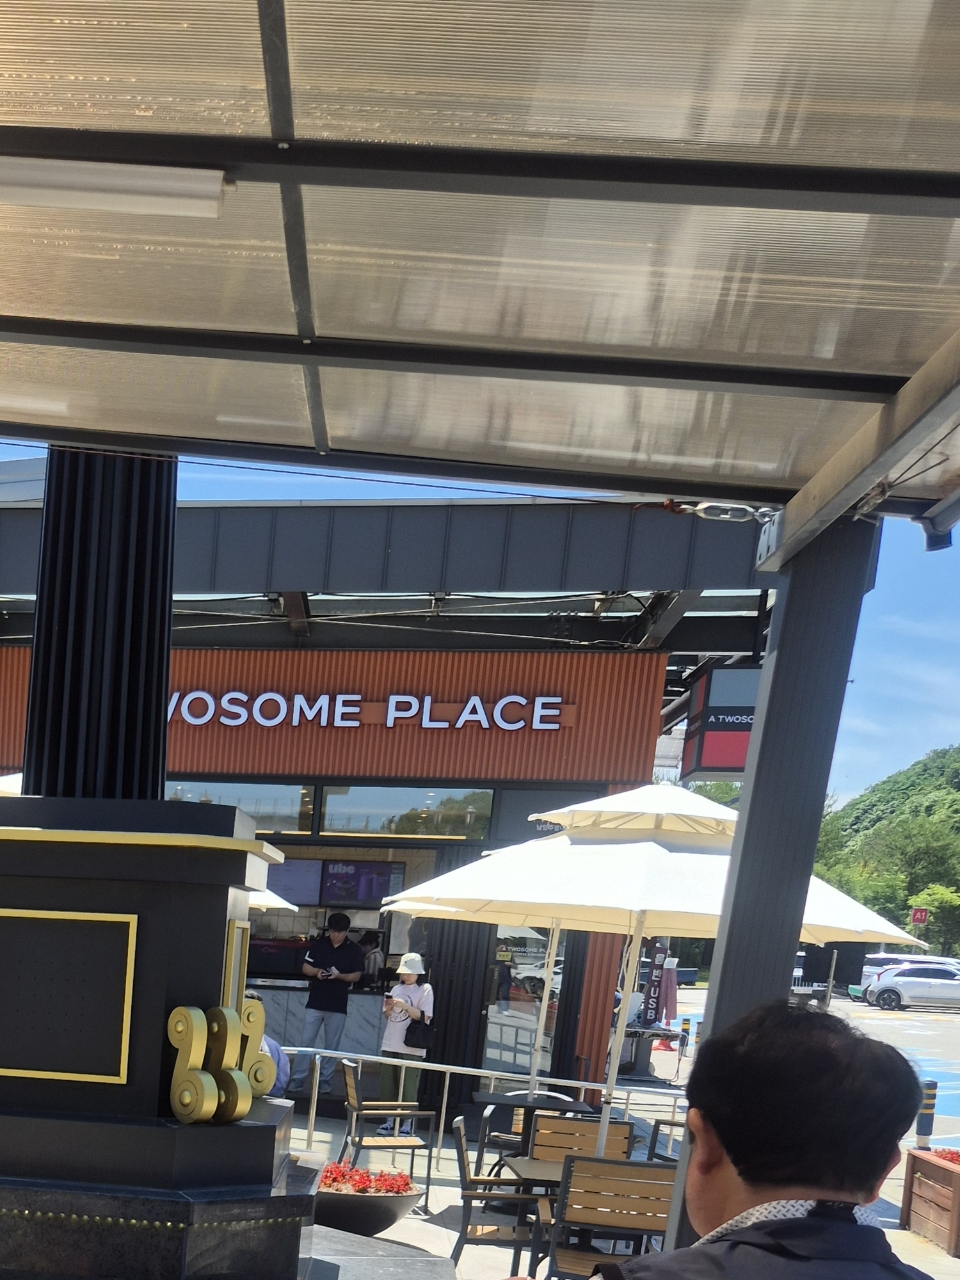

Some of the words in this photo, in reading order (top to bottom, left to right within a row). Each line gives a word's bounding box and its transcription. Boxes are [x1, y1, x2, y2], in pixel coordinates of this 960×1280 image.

[386, 694, 563, 731] PLACE
[708, 715, 716, 723] A
[328, 863, 355, 875] ube
[913, 911, 926, 920] A1
